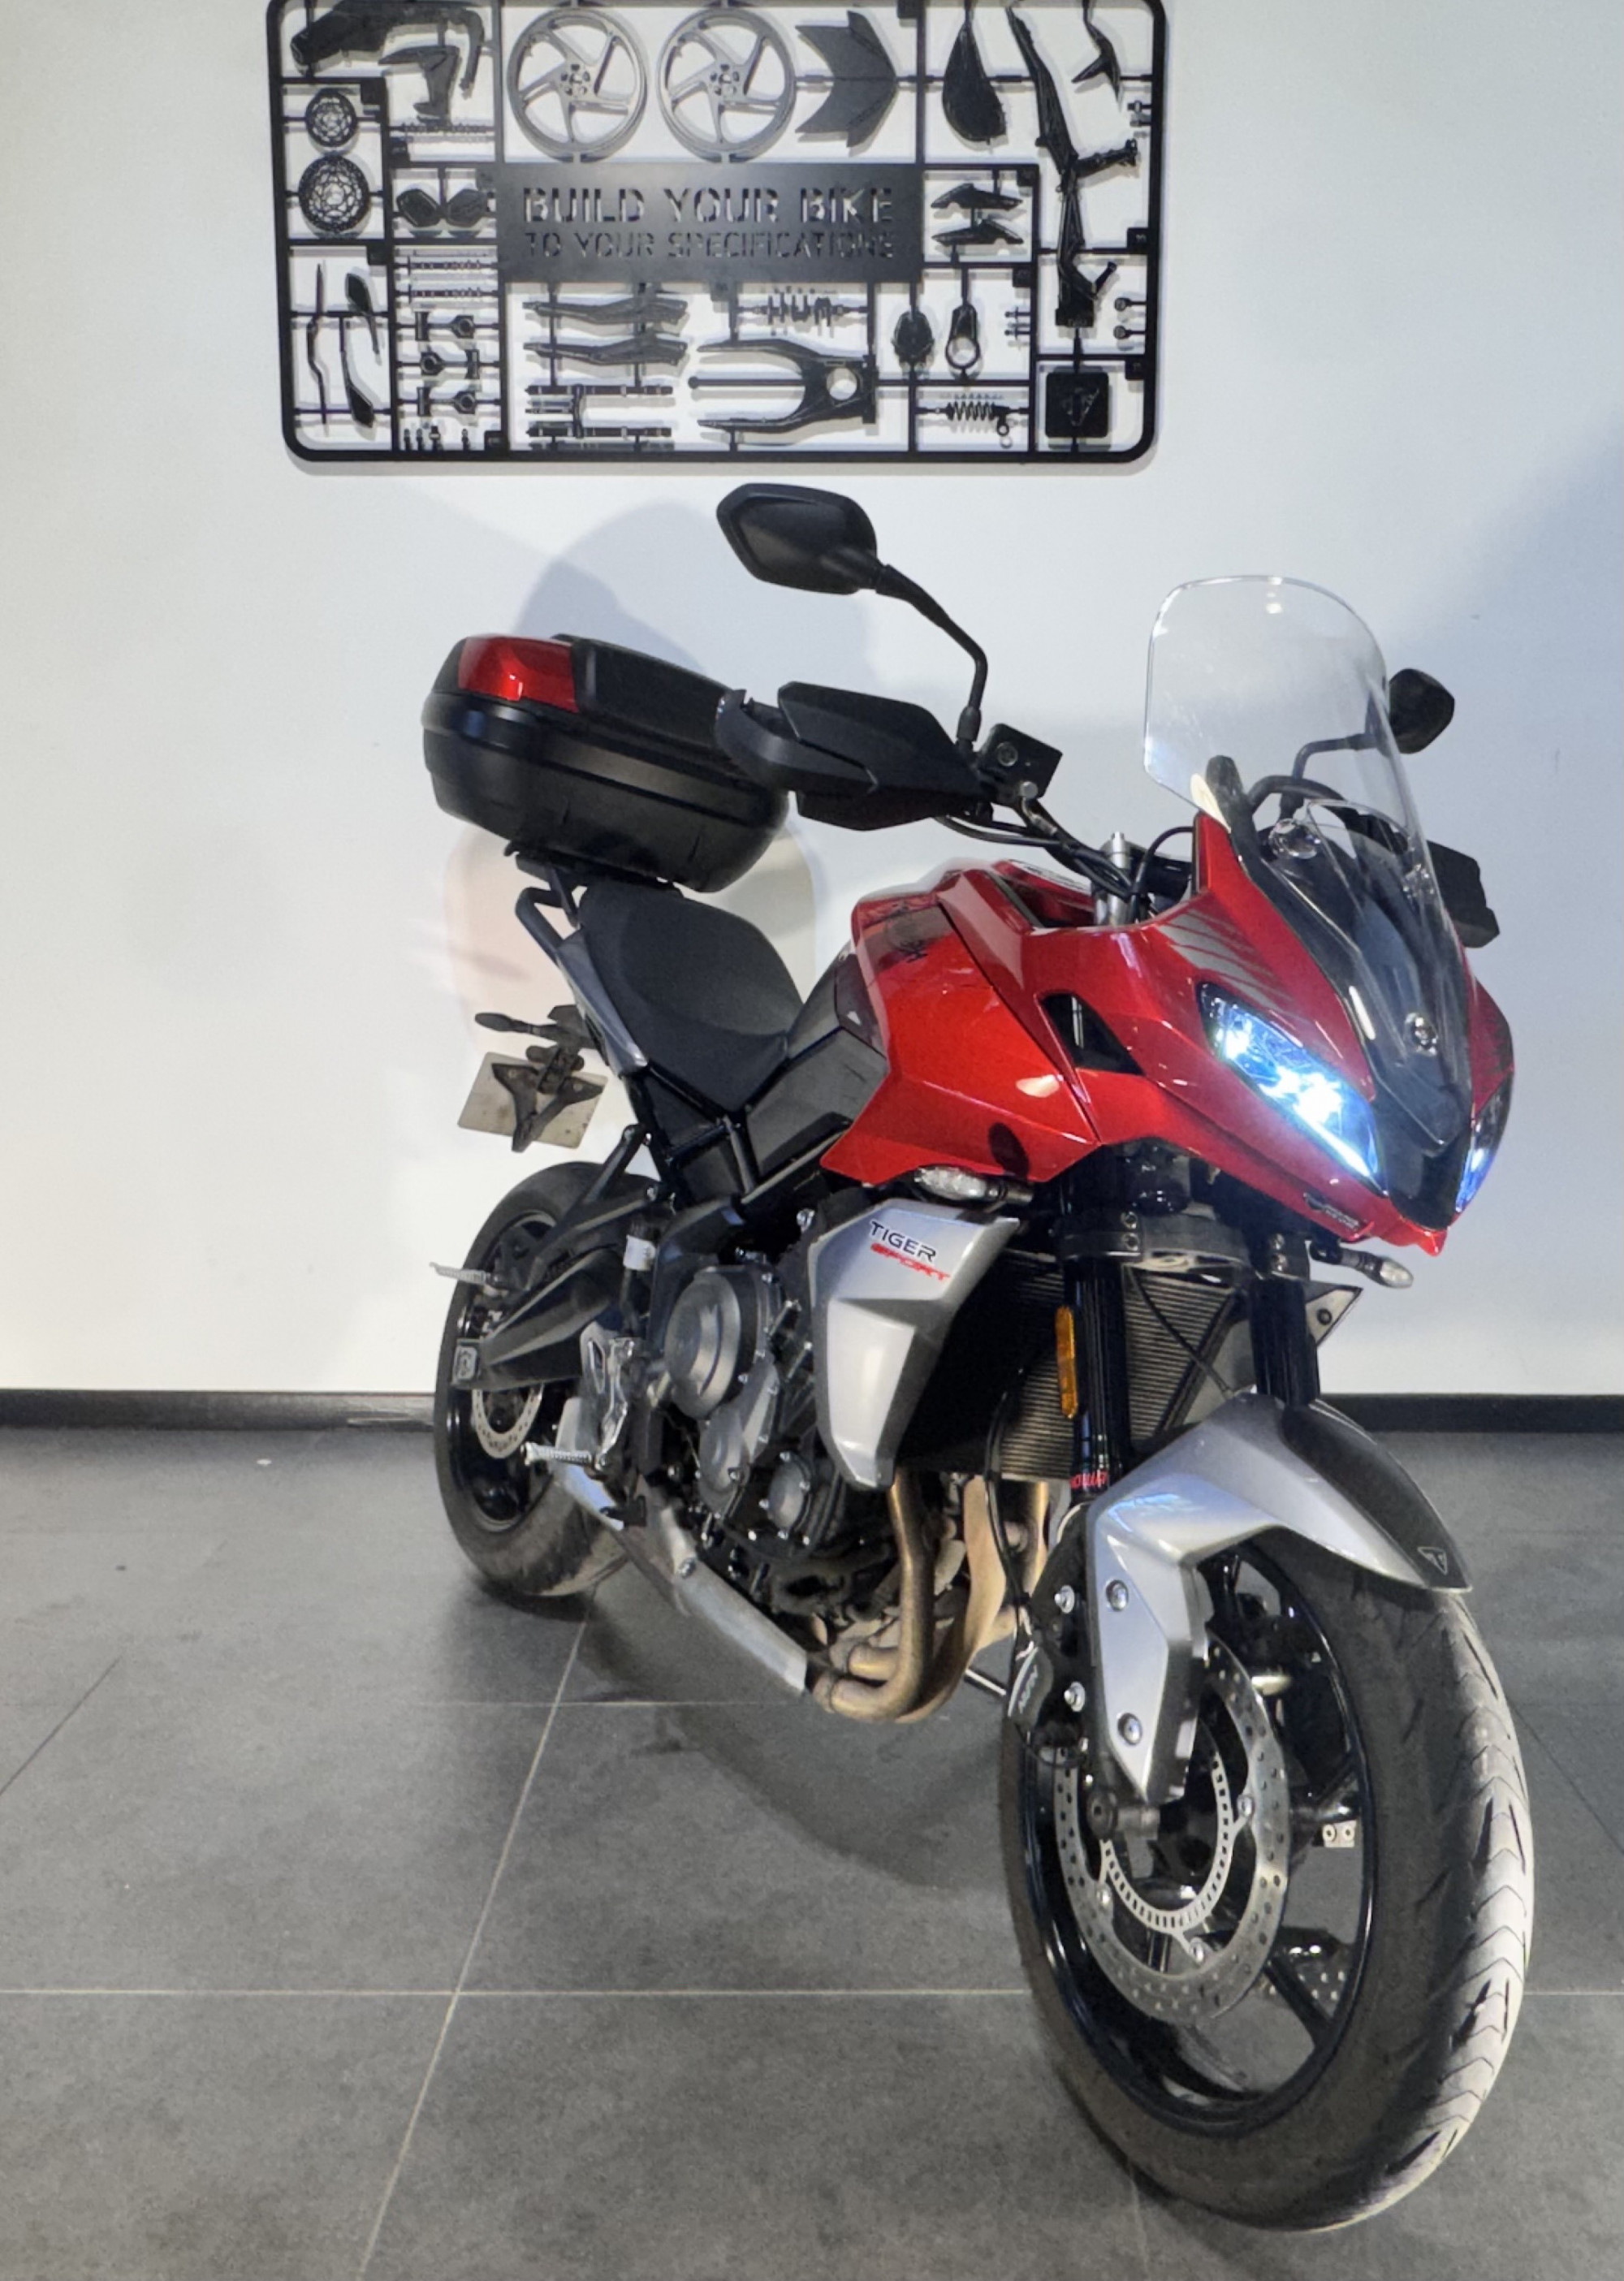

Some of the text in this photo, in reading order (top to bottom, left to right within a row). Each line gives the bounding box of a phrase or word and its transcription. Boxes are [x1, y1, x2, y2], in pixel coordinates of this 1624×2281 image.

[523, 188, 892, 223] BUILD YOUR BIKE
[525, 231, 893, 258] TO YOUR SPECIFICATIONS
[870, 1220, 936, 1263] TIGER
